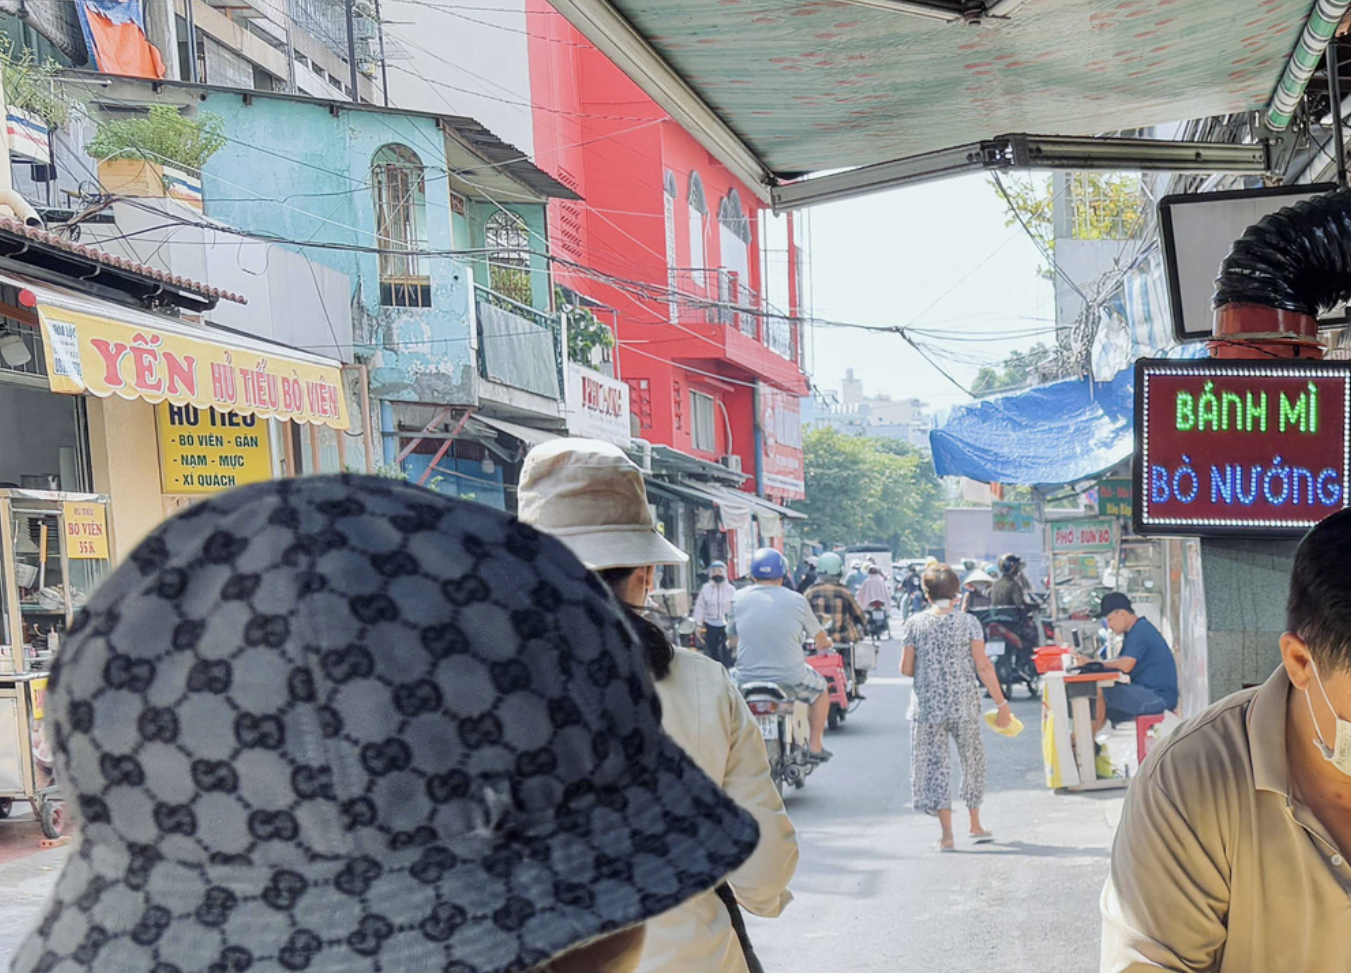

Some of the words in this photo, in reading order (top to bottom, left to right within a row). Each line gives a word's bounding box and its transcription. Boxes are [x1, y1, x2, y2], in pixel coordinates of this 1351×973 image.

[90, 332, 196, 397] YẾN
[210, 350, 237, 403] HỦ
[239, 358, 279, 411] TIẾU
[281, 368, 304, 413] BÒ
[306, 374, 340, 420] VIÊN
[1176, 379, 1268, 432] BÁNH
[1279, 379, 1318, 433] MÌ
[178, 432, 194, 447] BÒ
[197, 432, 224, 447] VIÊN
[235, 433, 259, 448] GÂN
[181, 454, 208, 468] NẠM
[219, 454, 245, 469] MỰC
[183, 474, 194, 486] XÍ
[197, 474, 236, 487] QUÁCH
[1151, 454, 1198, 504] BÒ
[1210, 454, 1342, 506] NƯỚNG
[68, 518, 80, 535] BÒ
[81, 519, 103, 536] VIÊN
